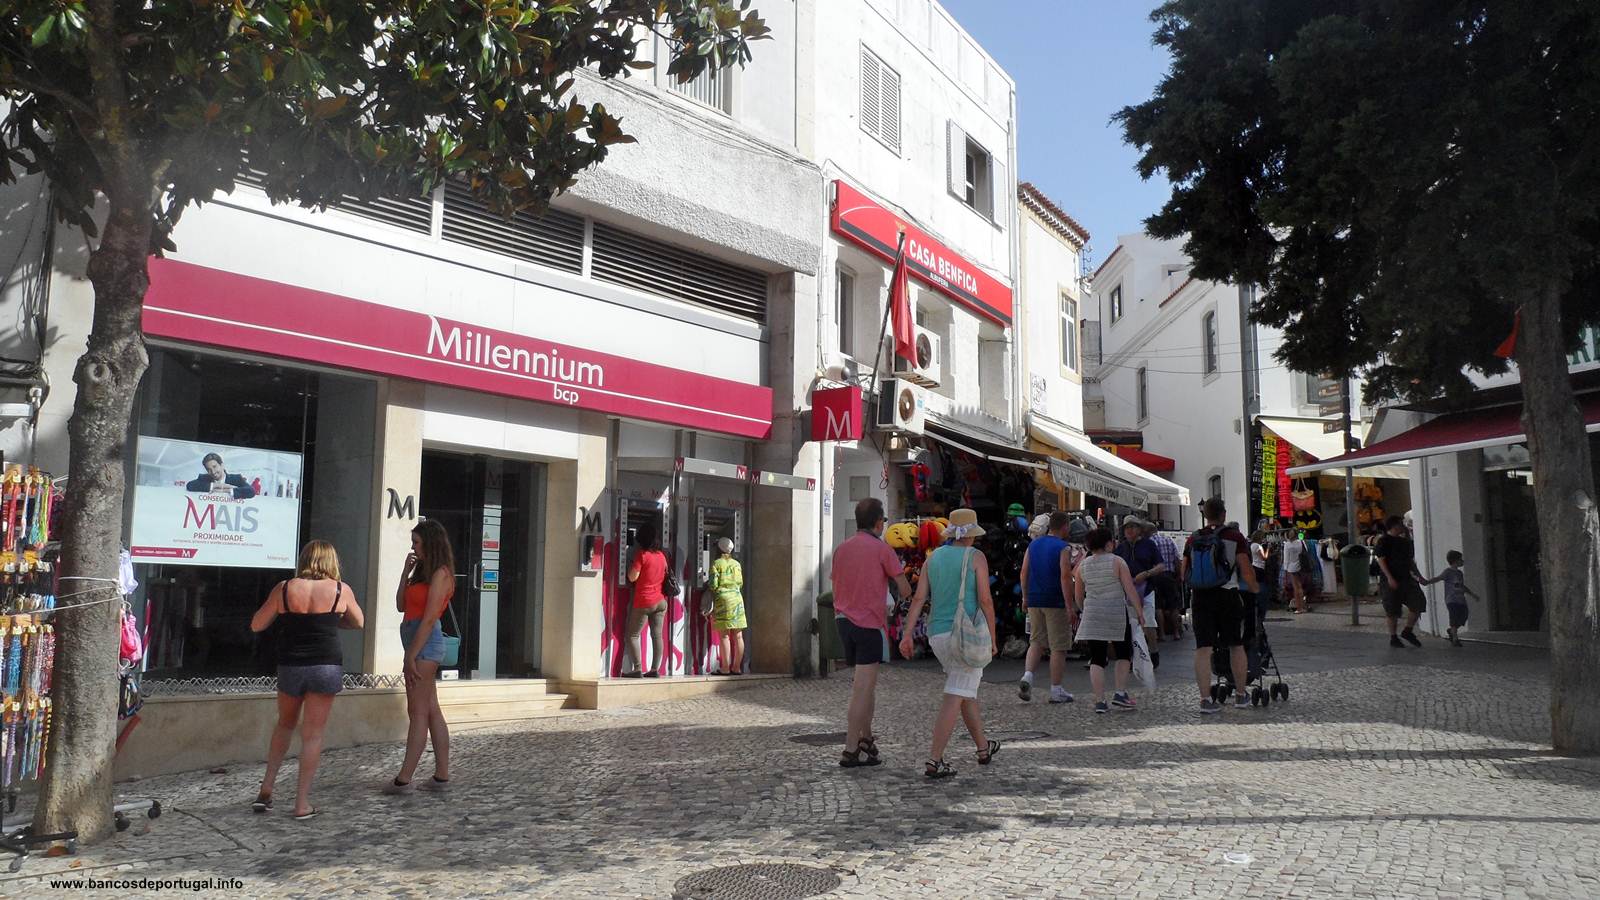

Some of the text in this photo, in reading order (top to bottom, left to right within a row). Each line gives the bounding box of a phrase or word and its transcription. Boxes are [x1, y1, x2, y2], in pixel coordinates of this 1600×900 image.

[910, 239, 978, 295] CASA BENFICA
[427, 314, 604, 387] Millennium
[553, 383, 579, 405] bcp
[824, 406, 852, 440] M
[737, 468, 746, 480] M
[807, 481, 815, 491] M
[198, 494, 245, 504] CONSEGUIMOS
[386, 487, 415, 521] M
[183, 495, 259, 533] MAIS
[579, 506, 602, 533] M
[193, 532, 244, 542] PROXIMIDADE
